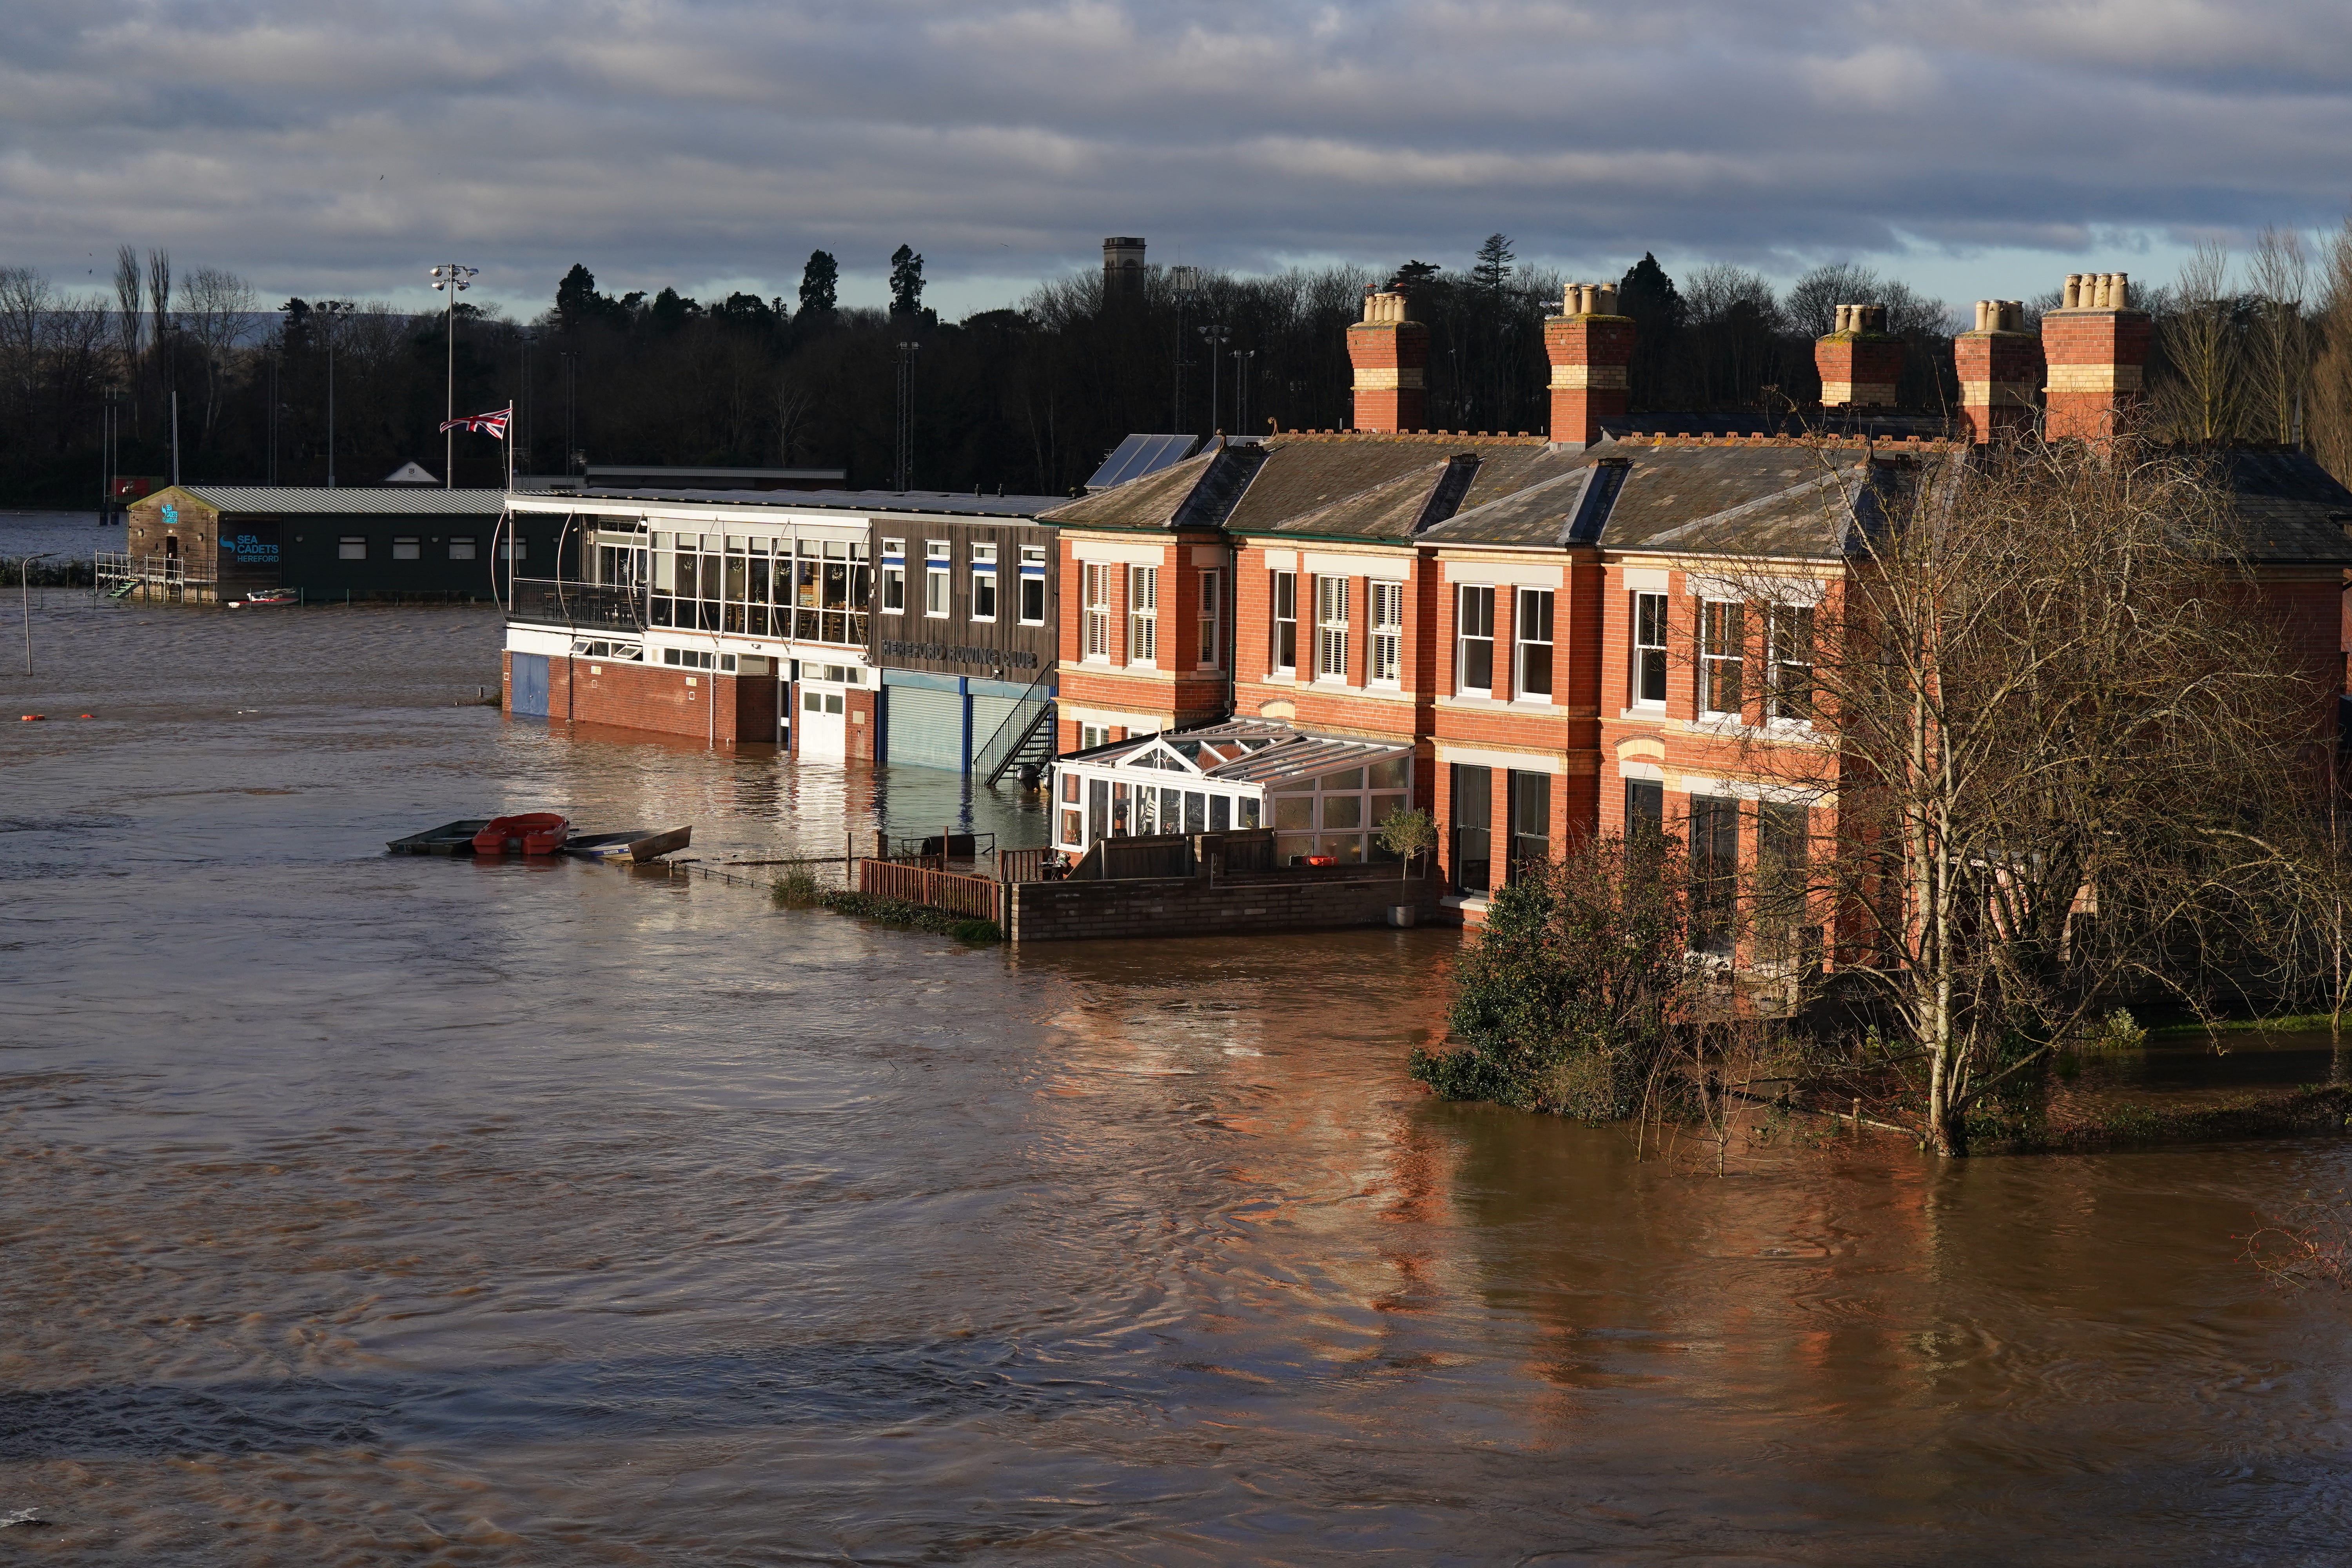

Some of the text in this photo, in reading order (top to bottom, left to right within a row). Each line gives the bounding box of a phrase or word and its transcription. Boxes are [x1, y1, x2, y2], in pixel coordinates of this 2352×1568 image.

[237, 535, 258, 544] SEA
[237, 544, 278, 554] CADETS
[882, 640, 1037, 669] HEREFORD ROWING CLUB
